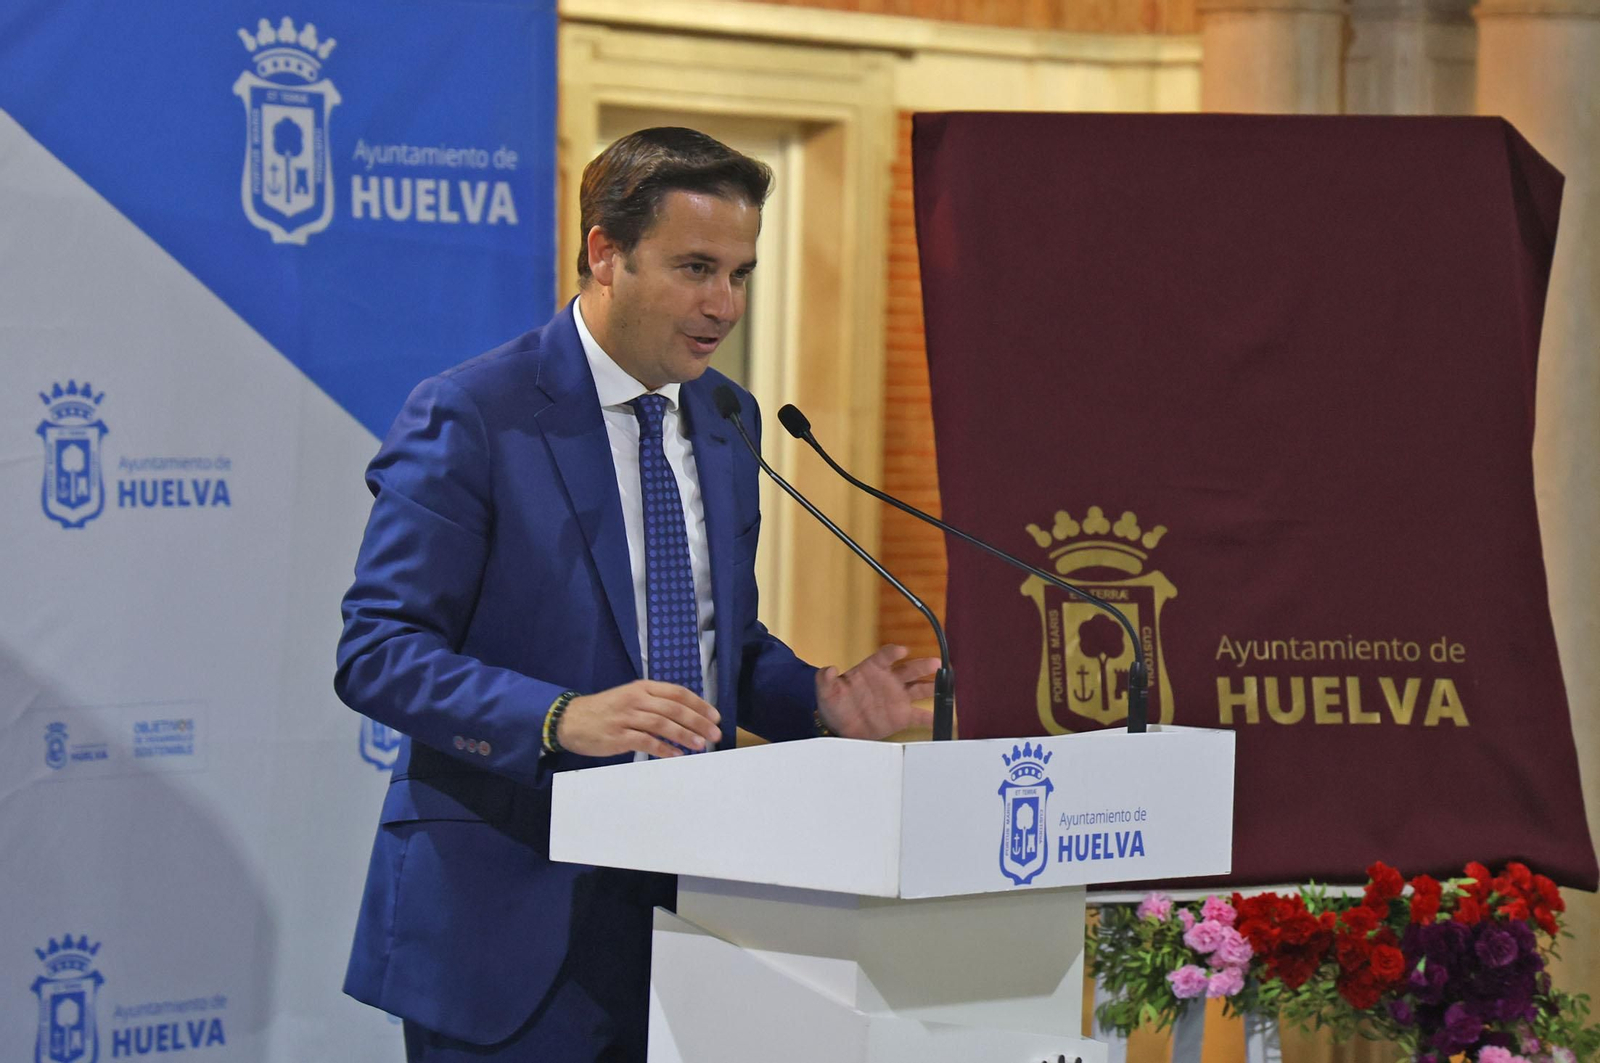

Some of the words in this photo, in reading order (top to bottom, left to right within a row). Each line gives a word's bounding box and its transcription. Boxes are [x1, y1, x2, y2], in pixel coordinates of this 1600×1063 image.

[352, 139, 489, 170] Ayuntamiento
[493, 146, 518, 170] de
[351, 174, 519, 225] HUELVA
[118, 456, 212, 474] Ayuntamiento
[214, 456, 232, 471] de
[117, 478, 231, 508] HUELVA
[1048, 609, 1061, 649] MARIS
[1216, 634, 1421, 667] Ayuntamiento
[1429, 636, 1467, 664] de
[1050, 654, 1064, 703] PORTUS
[1216, 675, 1470, 728] HUELVA
[1059, 808, 1131, 831] Ayuntamiento
[1133, 806, 1147, 822] de
[1057, 830, 1146, 863] HUELVA
[111, 1017, 226, 1059] HUELVA
